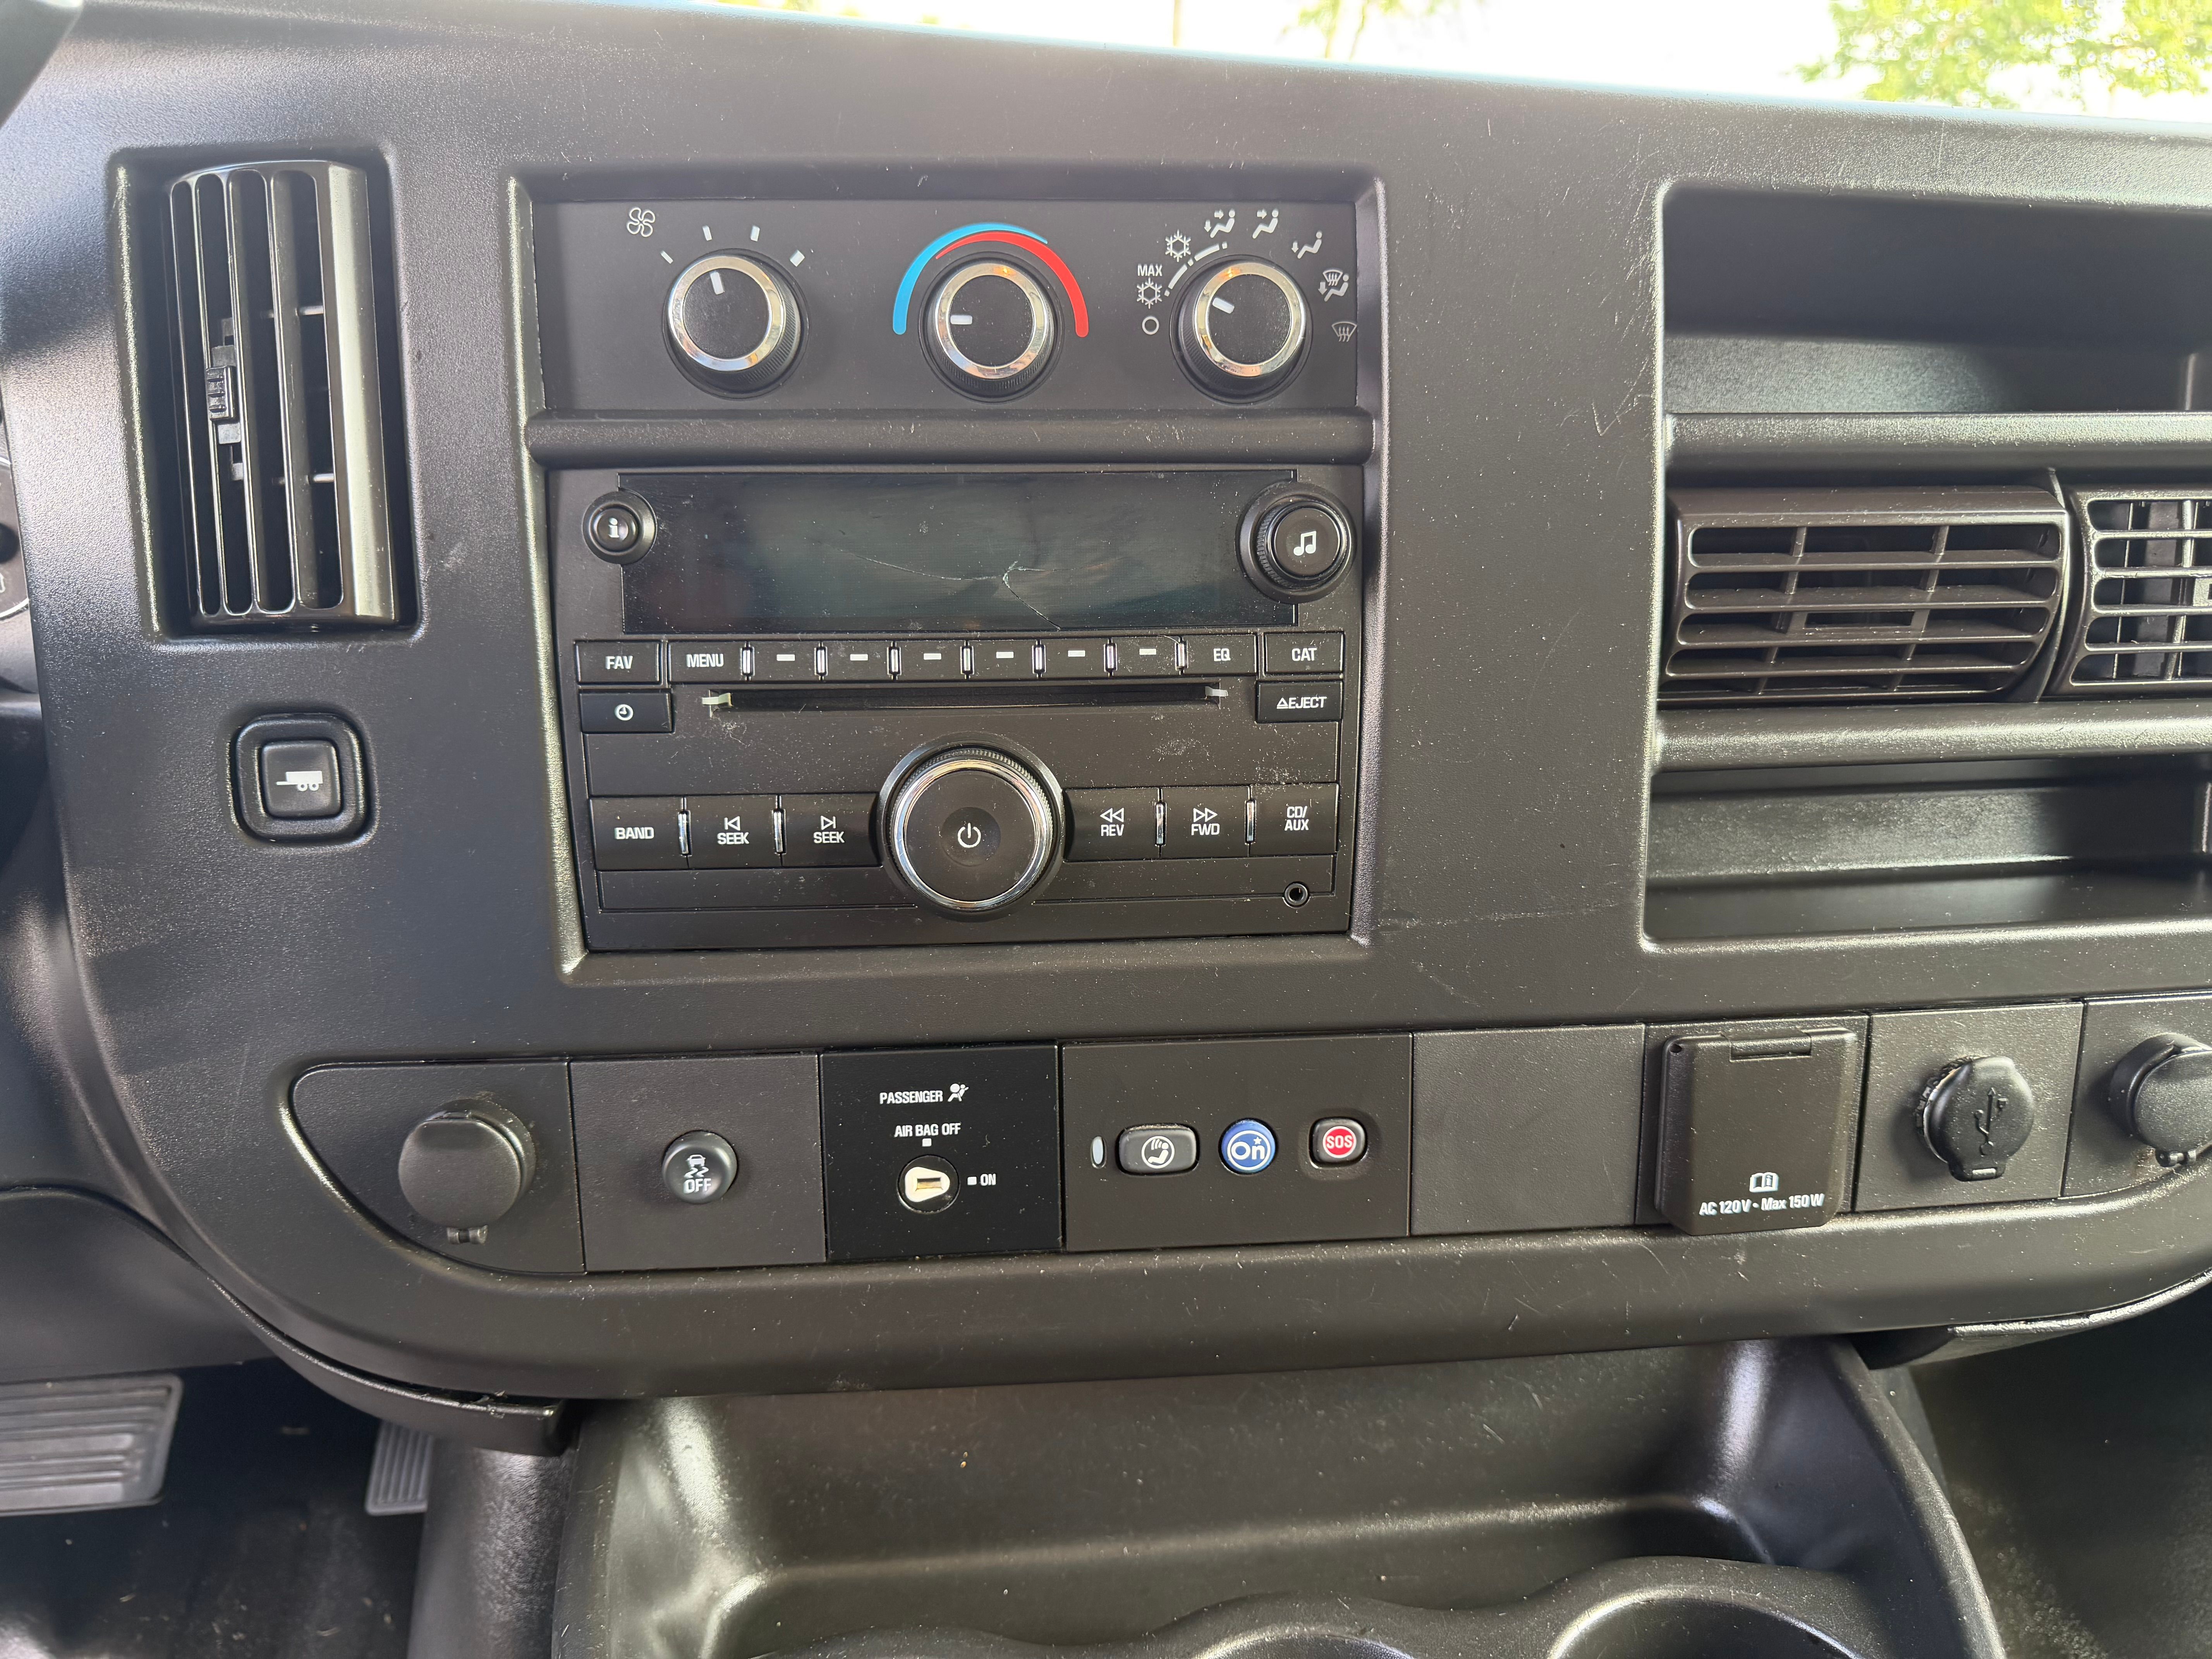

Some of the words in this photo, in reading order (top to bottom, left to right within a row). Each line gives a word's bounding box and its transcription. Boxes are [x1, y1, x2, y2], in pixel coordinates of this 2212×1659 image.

[1137, 264, 1163, 276] MAX
[686, 653, 724, 668] MENU
[1213, 648, 1231, 661] EQ
[1291, 647, 1317, 661] CAT
[606, 656, 633, 670] FAV
[1288, 696, 1327, 709] EJECT
[1286, 805, 1308, 818] CD/
[1101, 824, 1124, 836] REV
[1191, 823, 1220, 836] FWD
[1284, 819, 1309, 831] AUX
[615, 827, 654, 840] BAND
[717, 832, 750, 845] SEEK
[813, 831, 845, 843] SEEK
[879, 1090, 943, 1104] PASSENGER
[894, 1125, 913, 1137] AIR
[915, 1123, 939, 1137] BAG
[941, 1123, 961, 1135] OFF
[1326, 1135, 1353, 1149] SOS
[1231, 1141, 1265, 1160] On
[684, 1178, 711, 1194] OFF
[980, 1173, 996, 1186] ON
[1699, 1202, 1718, 1216] AC
[1761, 1197, 1787, 1211] Max
